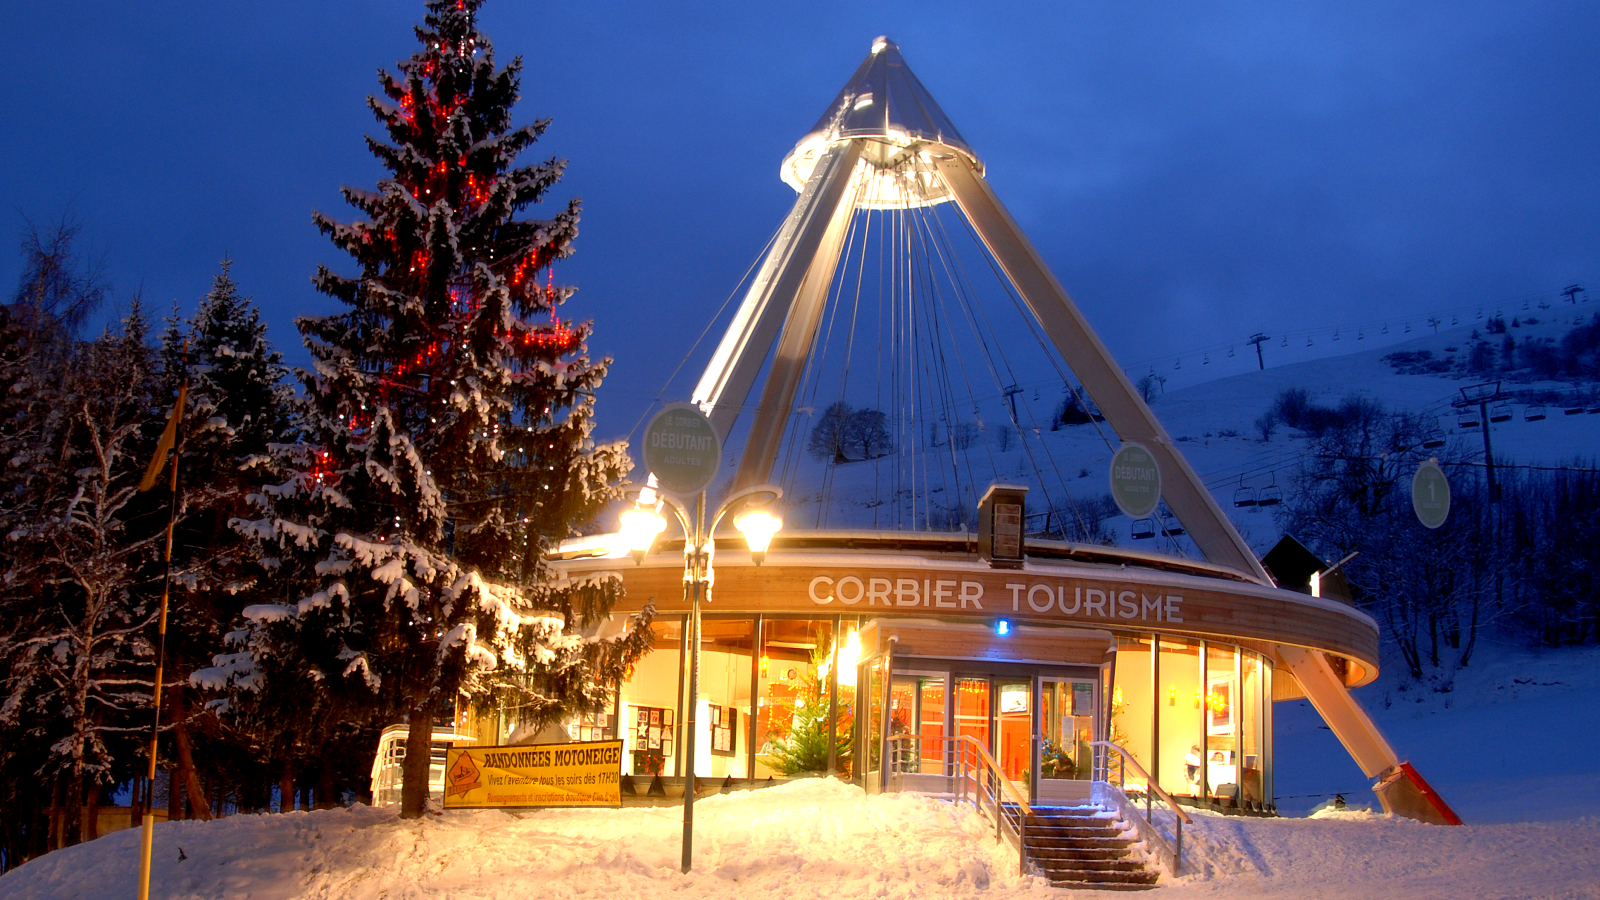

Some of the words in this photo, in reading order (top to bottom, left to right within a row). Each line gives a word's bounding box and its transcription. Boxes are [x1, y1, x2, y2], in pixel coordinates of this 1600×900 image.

[665, 416, 672, 426] LE
[652, 429, 712, 452] DÉBUTANT
[664, 455, 701, 466] ADULTES
[1428, 481, 1436, 502] 1
[808, 575, 984, 610] CORBIER
[1005, 583, 1184, 624] TOURISME
[554, 747, 620, 767] MOTONEIGE
[487, 774, 503, 786] Vivez
[539, 775, 554, 786] tous
[555, 774, 565, 786] les
[566, 773, 582, 785] soirs
[597, 771, 619, 784] 17H30
